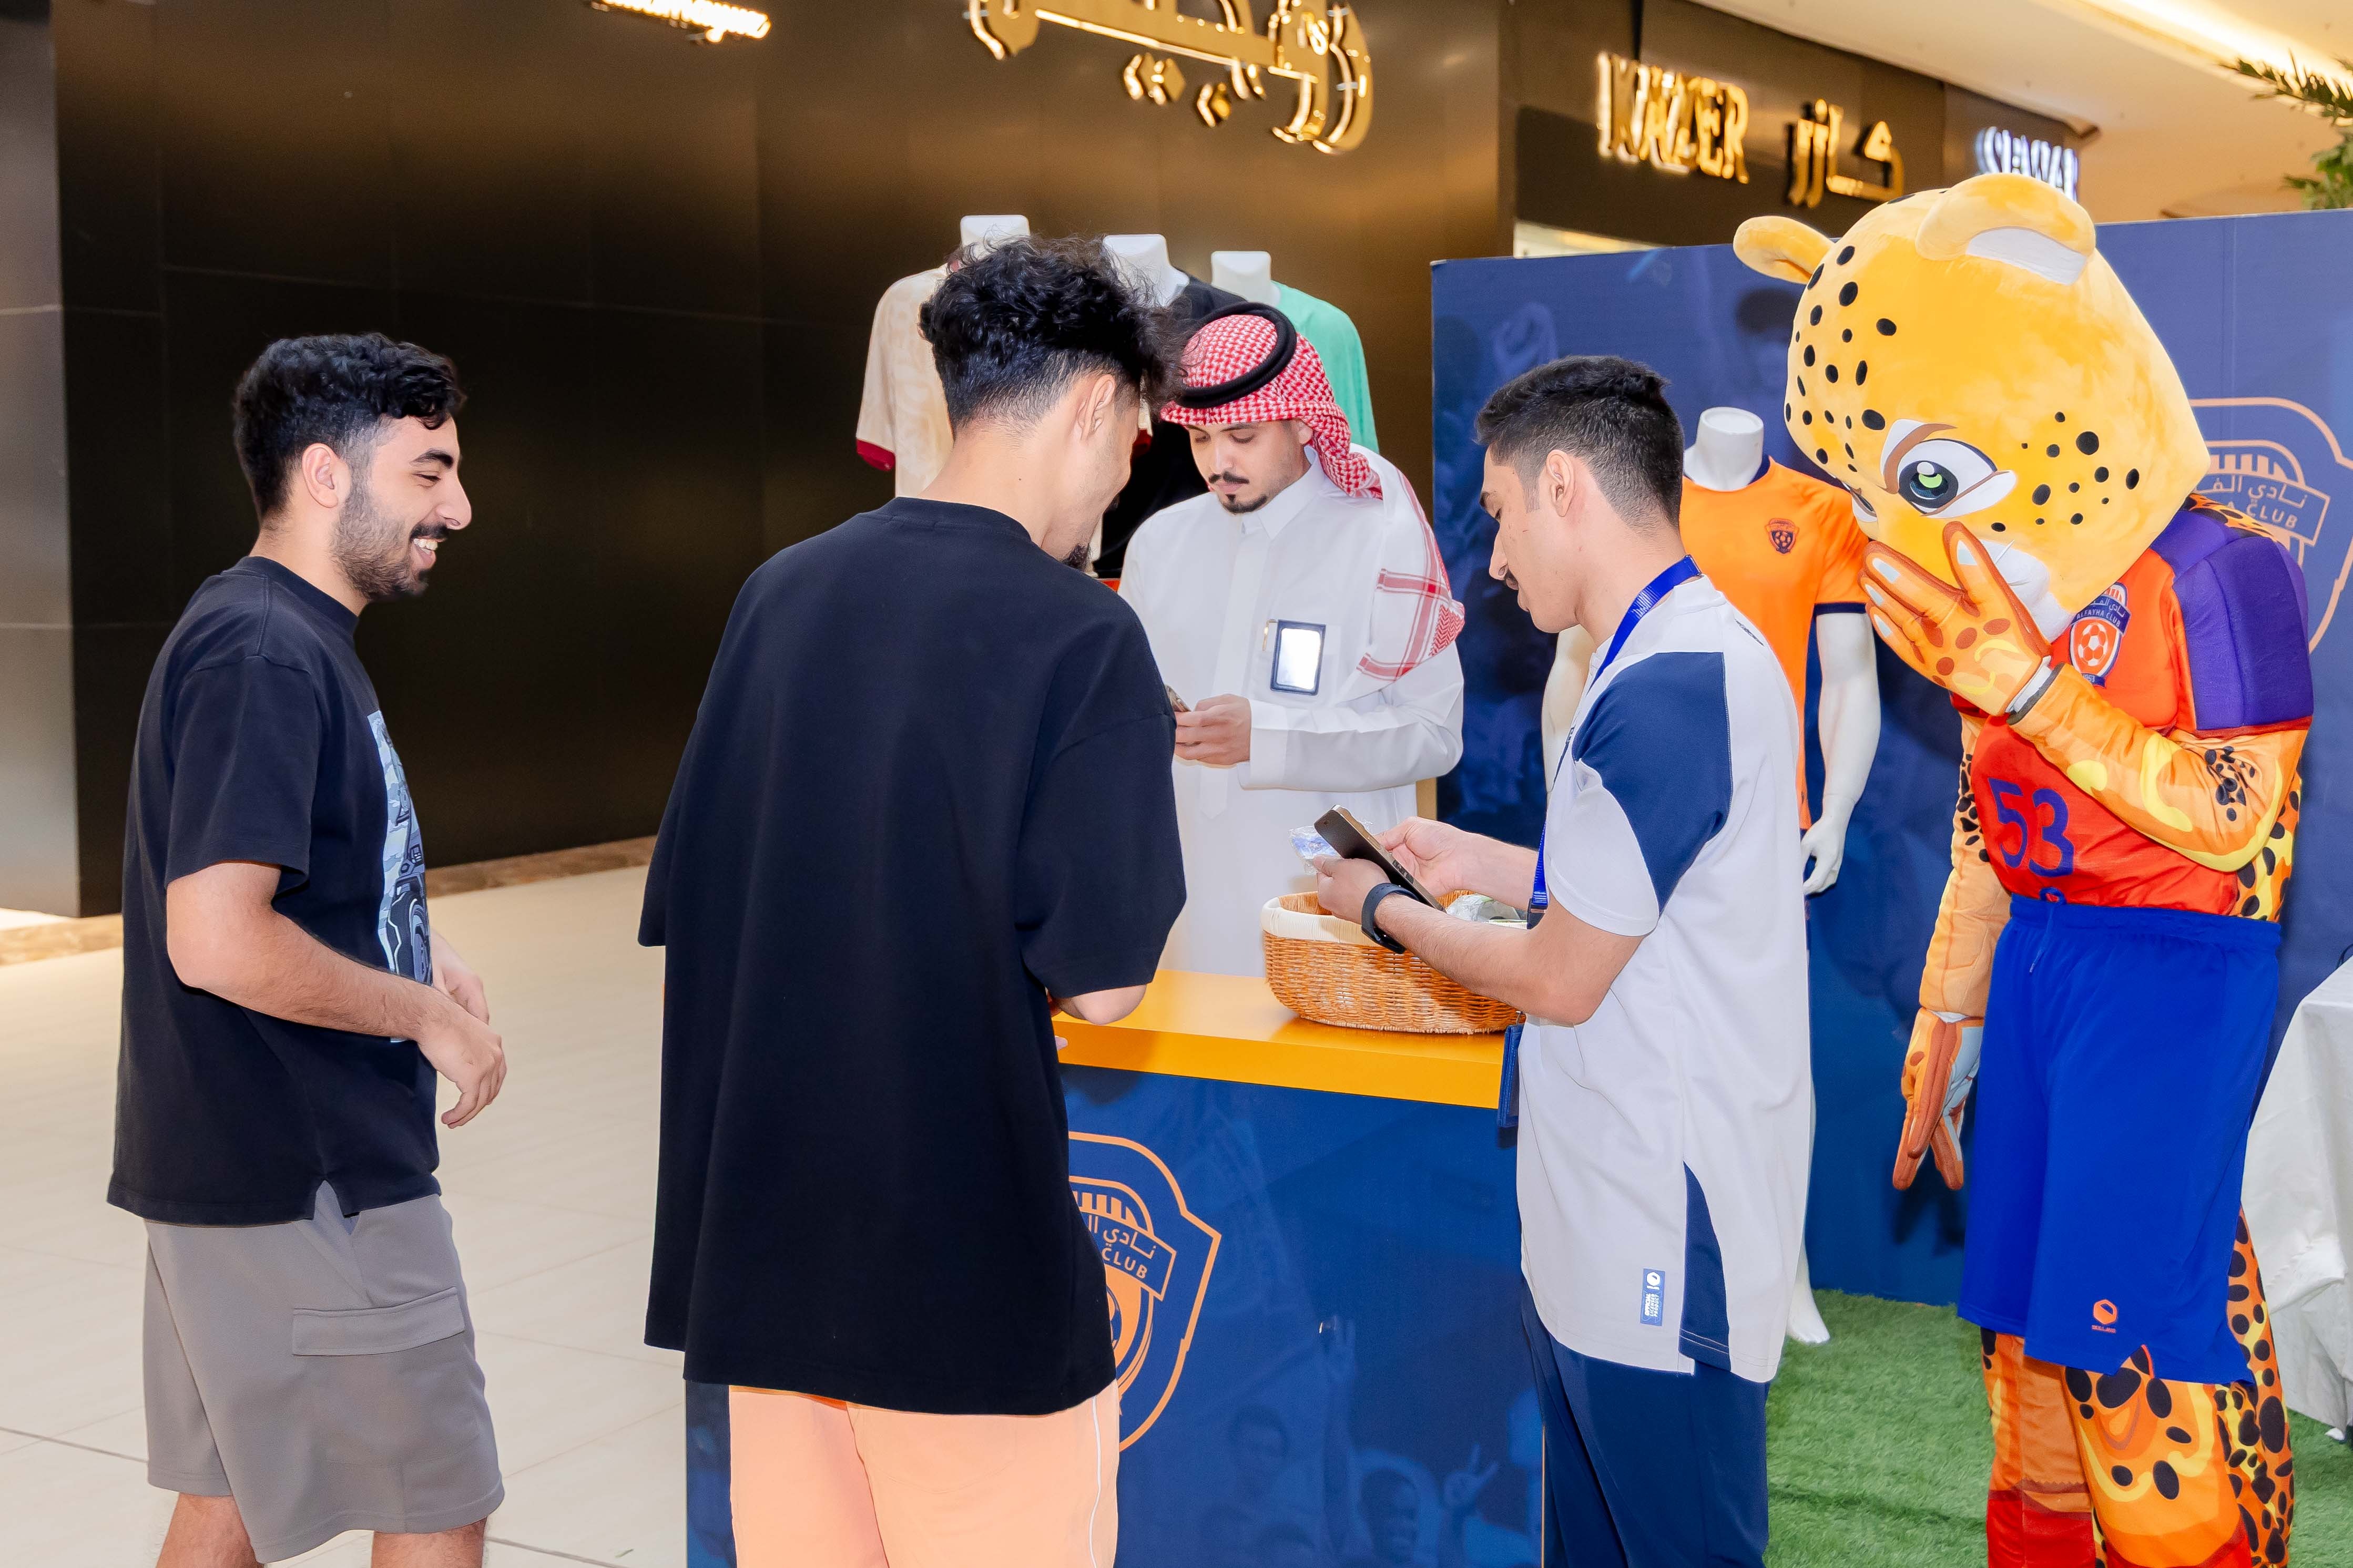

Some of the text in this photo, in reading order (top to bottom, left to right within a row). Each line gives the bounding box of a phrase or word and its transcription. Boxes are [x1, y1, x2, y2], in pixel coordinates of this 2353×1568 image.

[2248, 483, 2308, 509] نادي
[2246, 504, 2298, 528] CLUB
[2076, 609, 2121, 628] ALFAYHA CLUB
[1988, 776, 2074, 878] 53
[1103, 1228, 1157, 1259] نادي
[1102, 1247, 1147, 1279] CLUB
